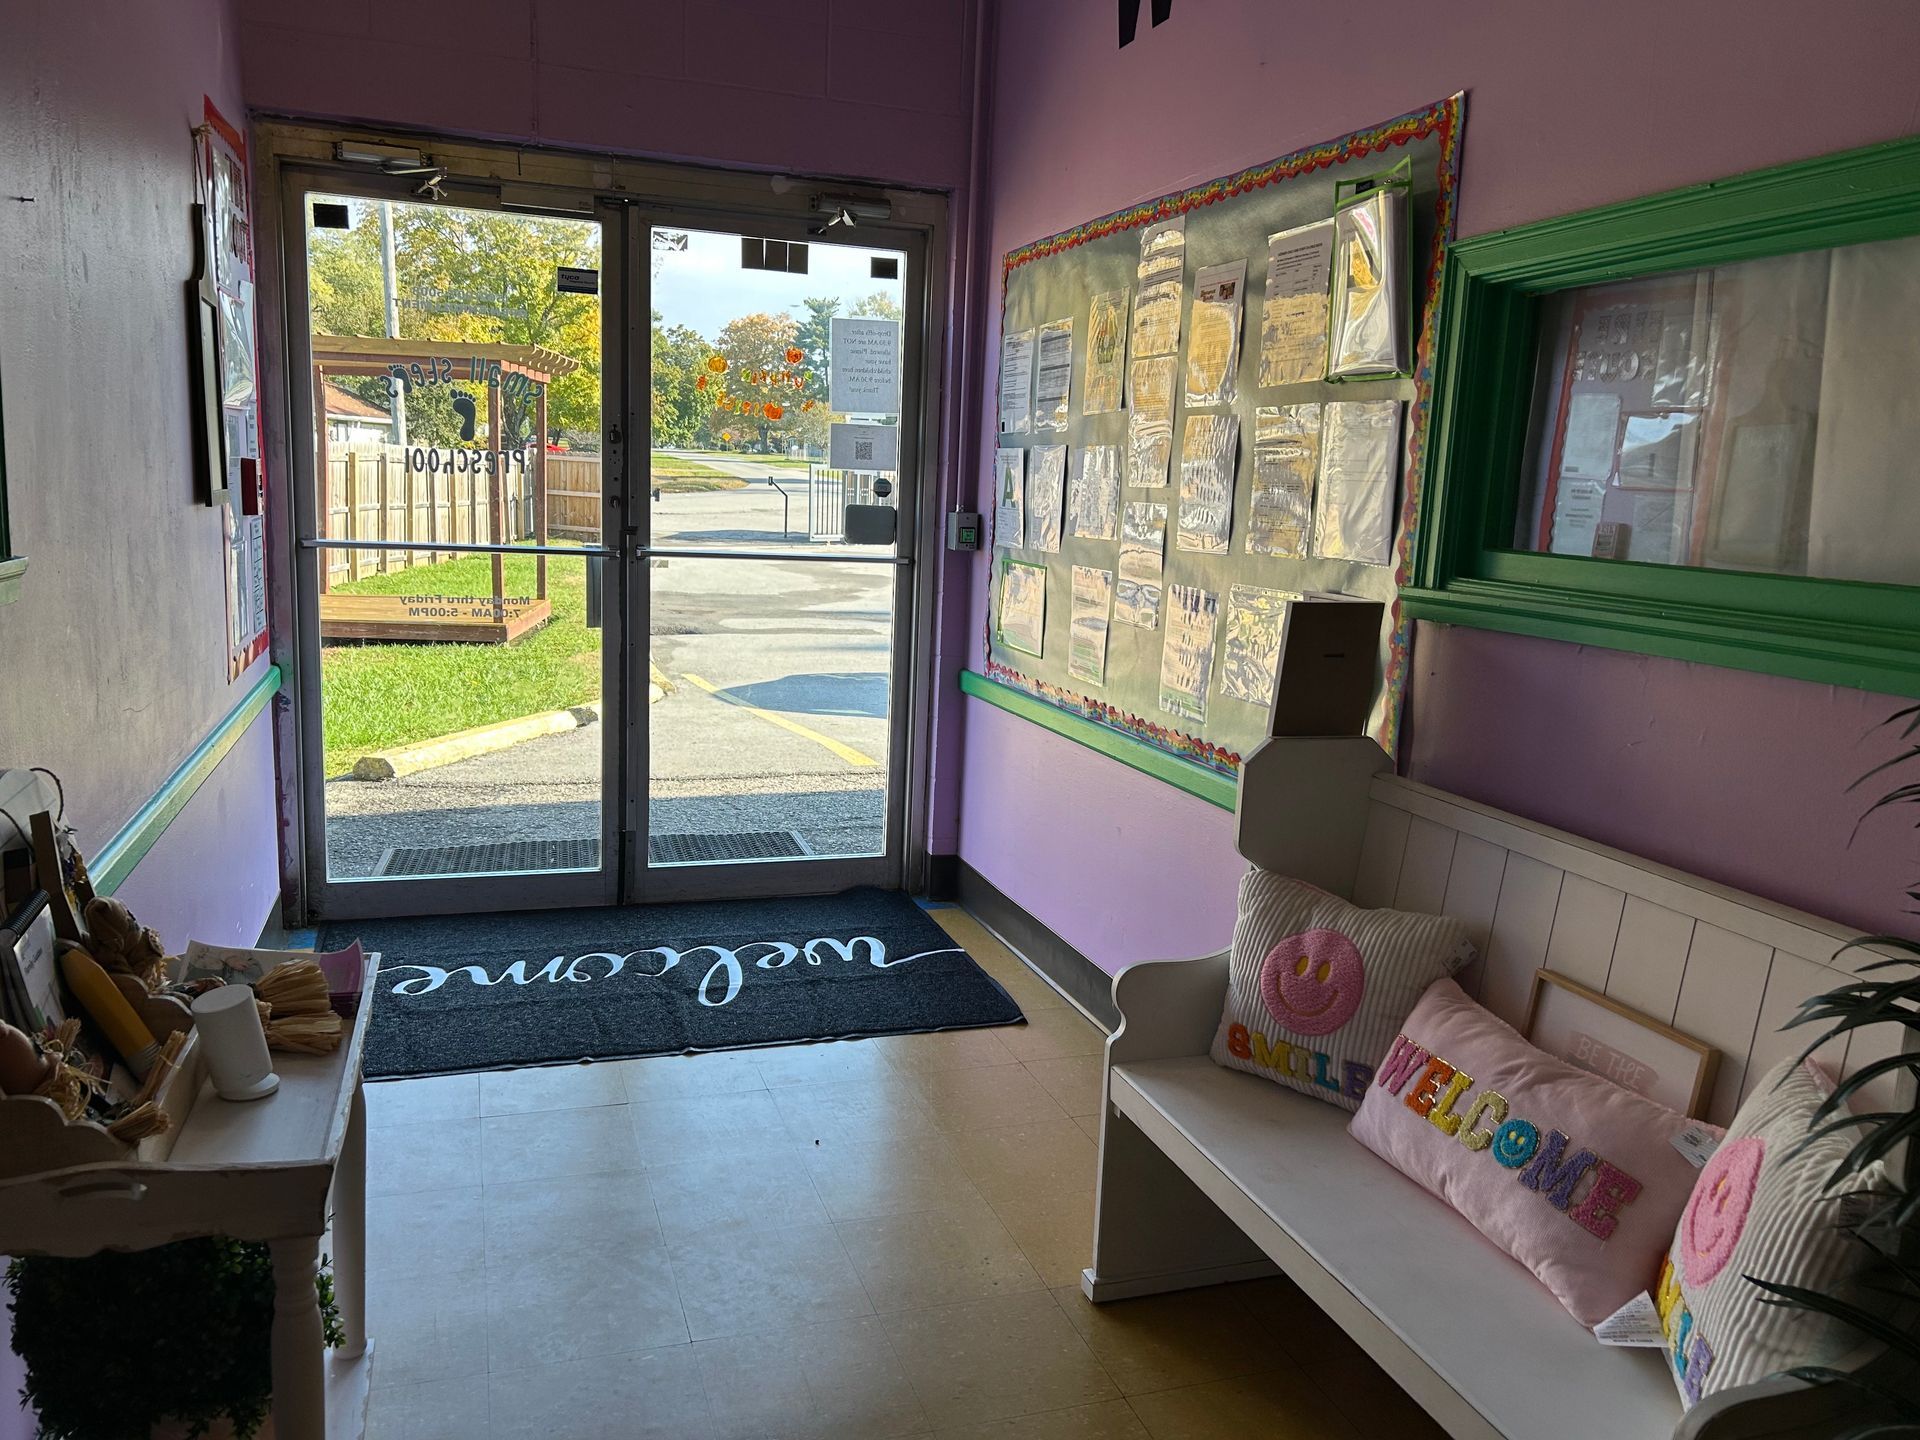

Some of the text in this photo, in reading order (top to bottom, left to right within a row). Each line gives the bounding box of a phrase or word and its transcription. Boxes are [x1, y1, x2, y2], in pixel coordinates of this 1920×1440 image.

[376, 936, 968, 1007] welcome
[1227, 1023, 1375, 1102] SMILE
[1577, 1034, 1646, 1091] BE THE
[1377, 1033, 1644, 1241] WELCOME
